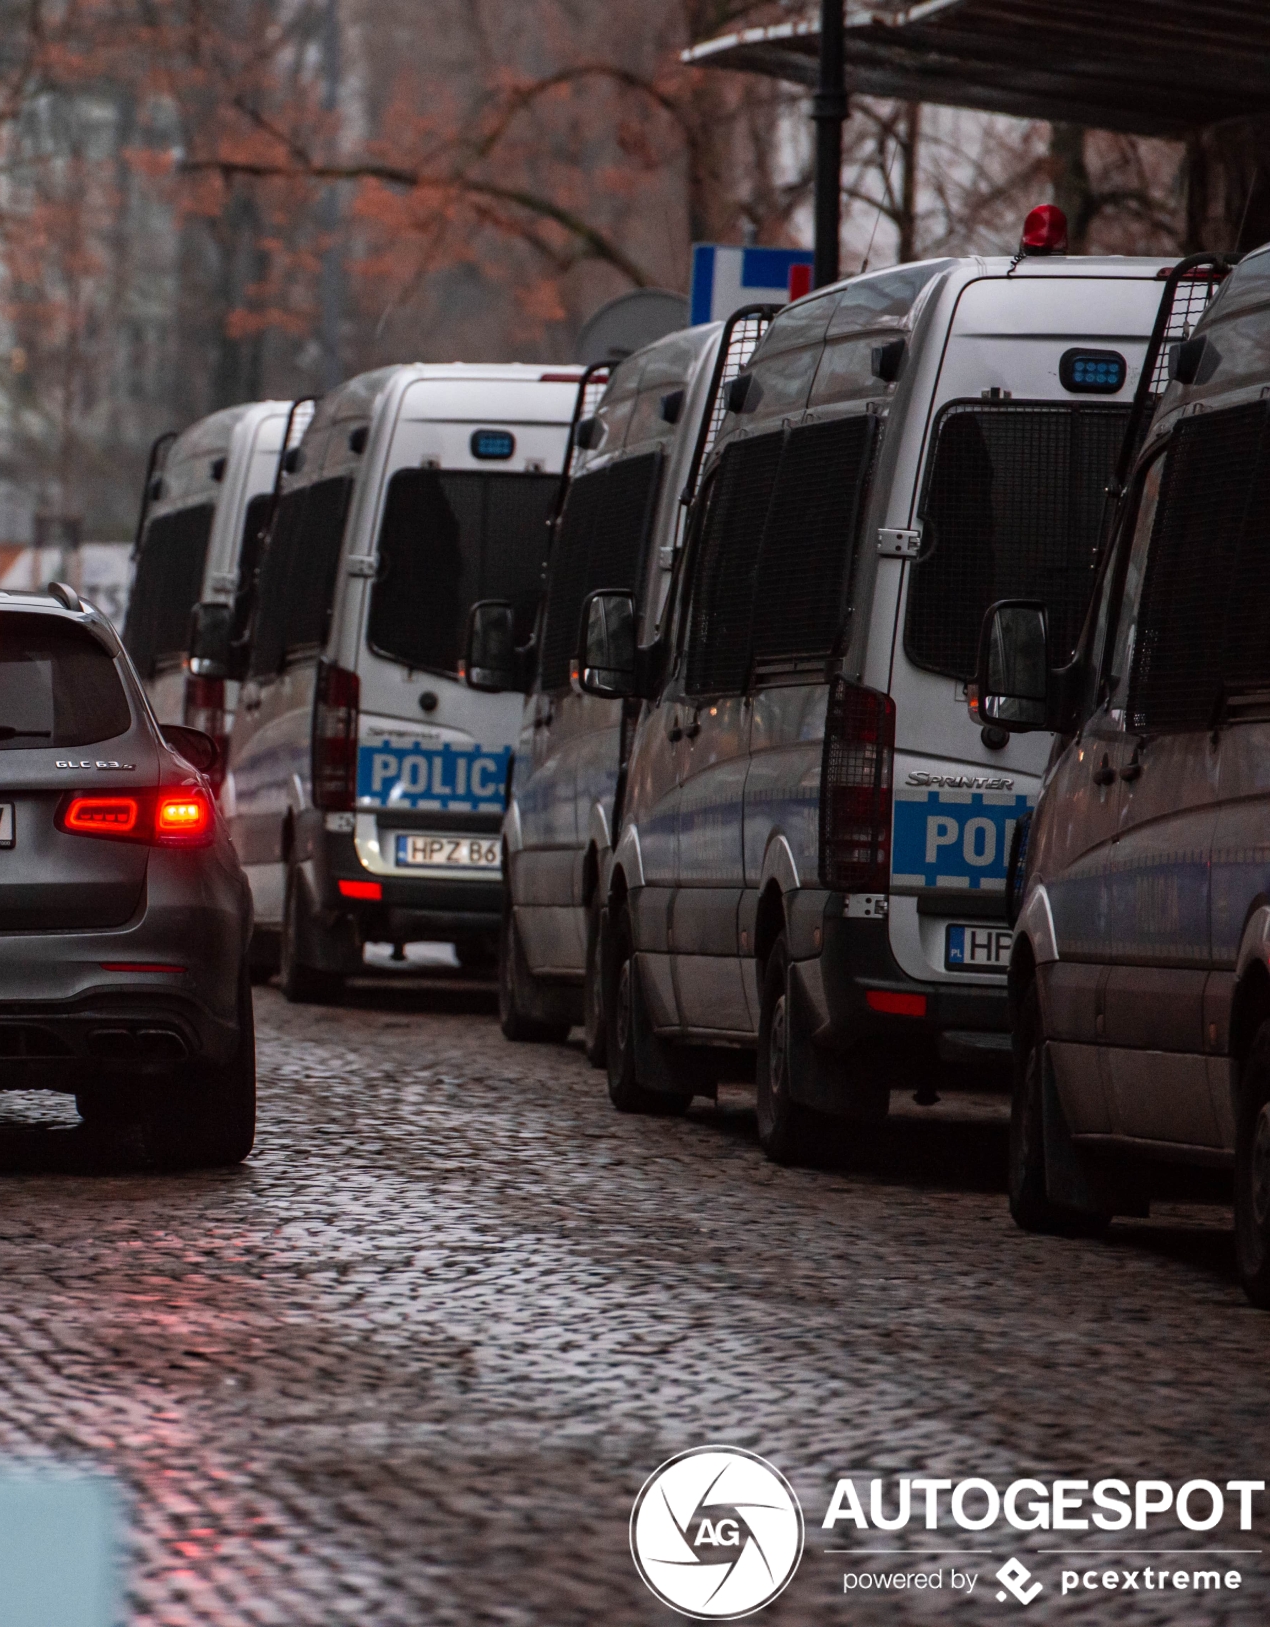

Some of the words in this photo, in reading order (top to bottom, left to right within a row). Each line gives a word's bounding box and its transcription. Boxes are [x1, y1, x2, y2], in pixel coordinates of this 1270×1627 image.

[55, 760, 91, 768] GLC
[411, 840, 461, 863] HPZ
[950, 948, 963, 958] PL
